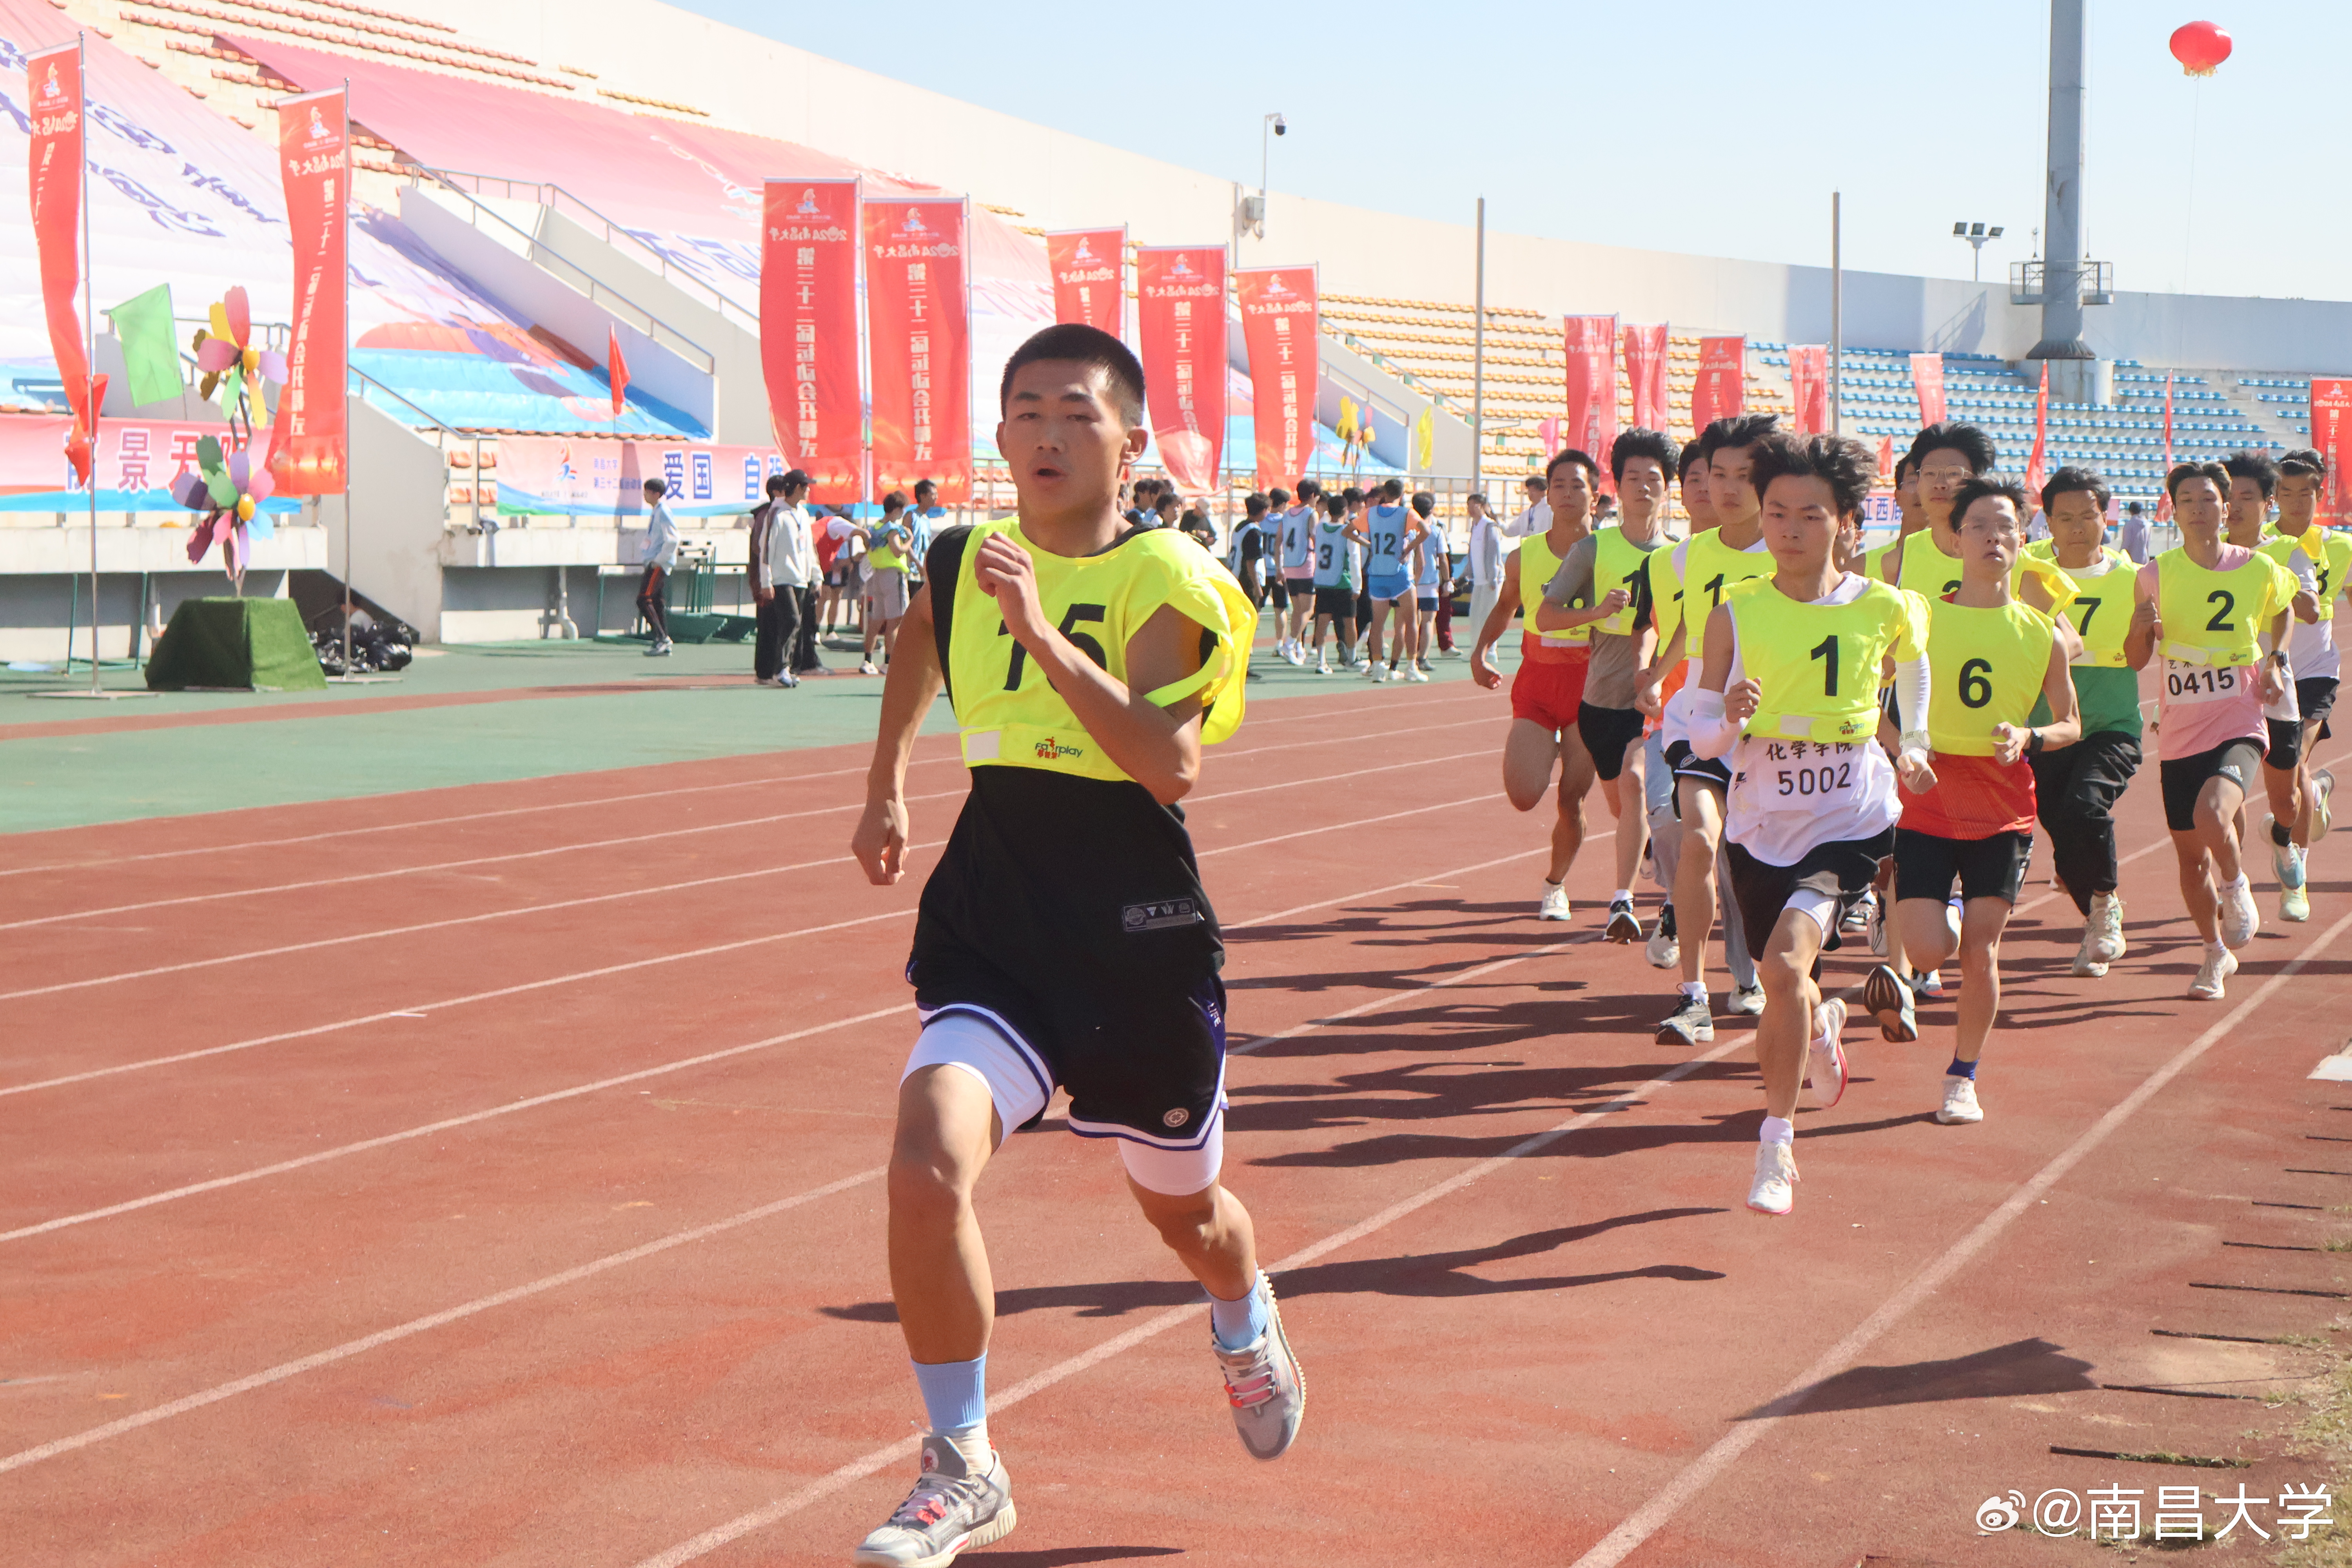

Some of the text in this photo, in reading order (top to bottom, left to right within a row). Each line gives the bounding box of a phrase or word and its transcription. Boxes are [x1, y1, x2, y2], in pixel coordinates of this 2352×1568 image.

[594, 458, 618, 470] 南昌大学
[664, 452, 711, 500] 爱国
[1286, 527, 1295, 552] 4
[1374, 532, 1396, 555] 12
[1319, 544, 1333, 570] 3
[2074, 597, 2101, 636] 7
[2206, 590, 2234, 632] 2
[1811, 635, 1838, 696] 1
[2169, 667, 2234, 696] 0415
[1958, 658, 1992, 708] 6
[1778, 762, 1851, 795] 5002
